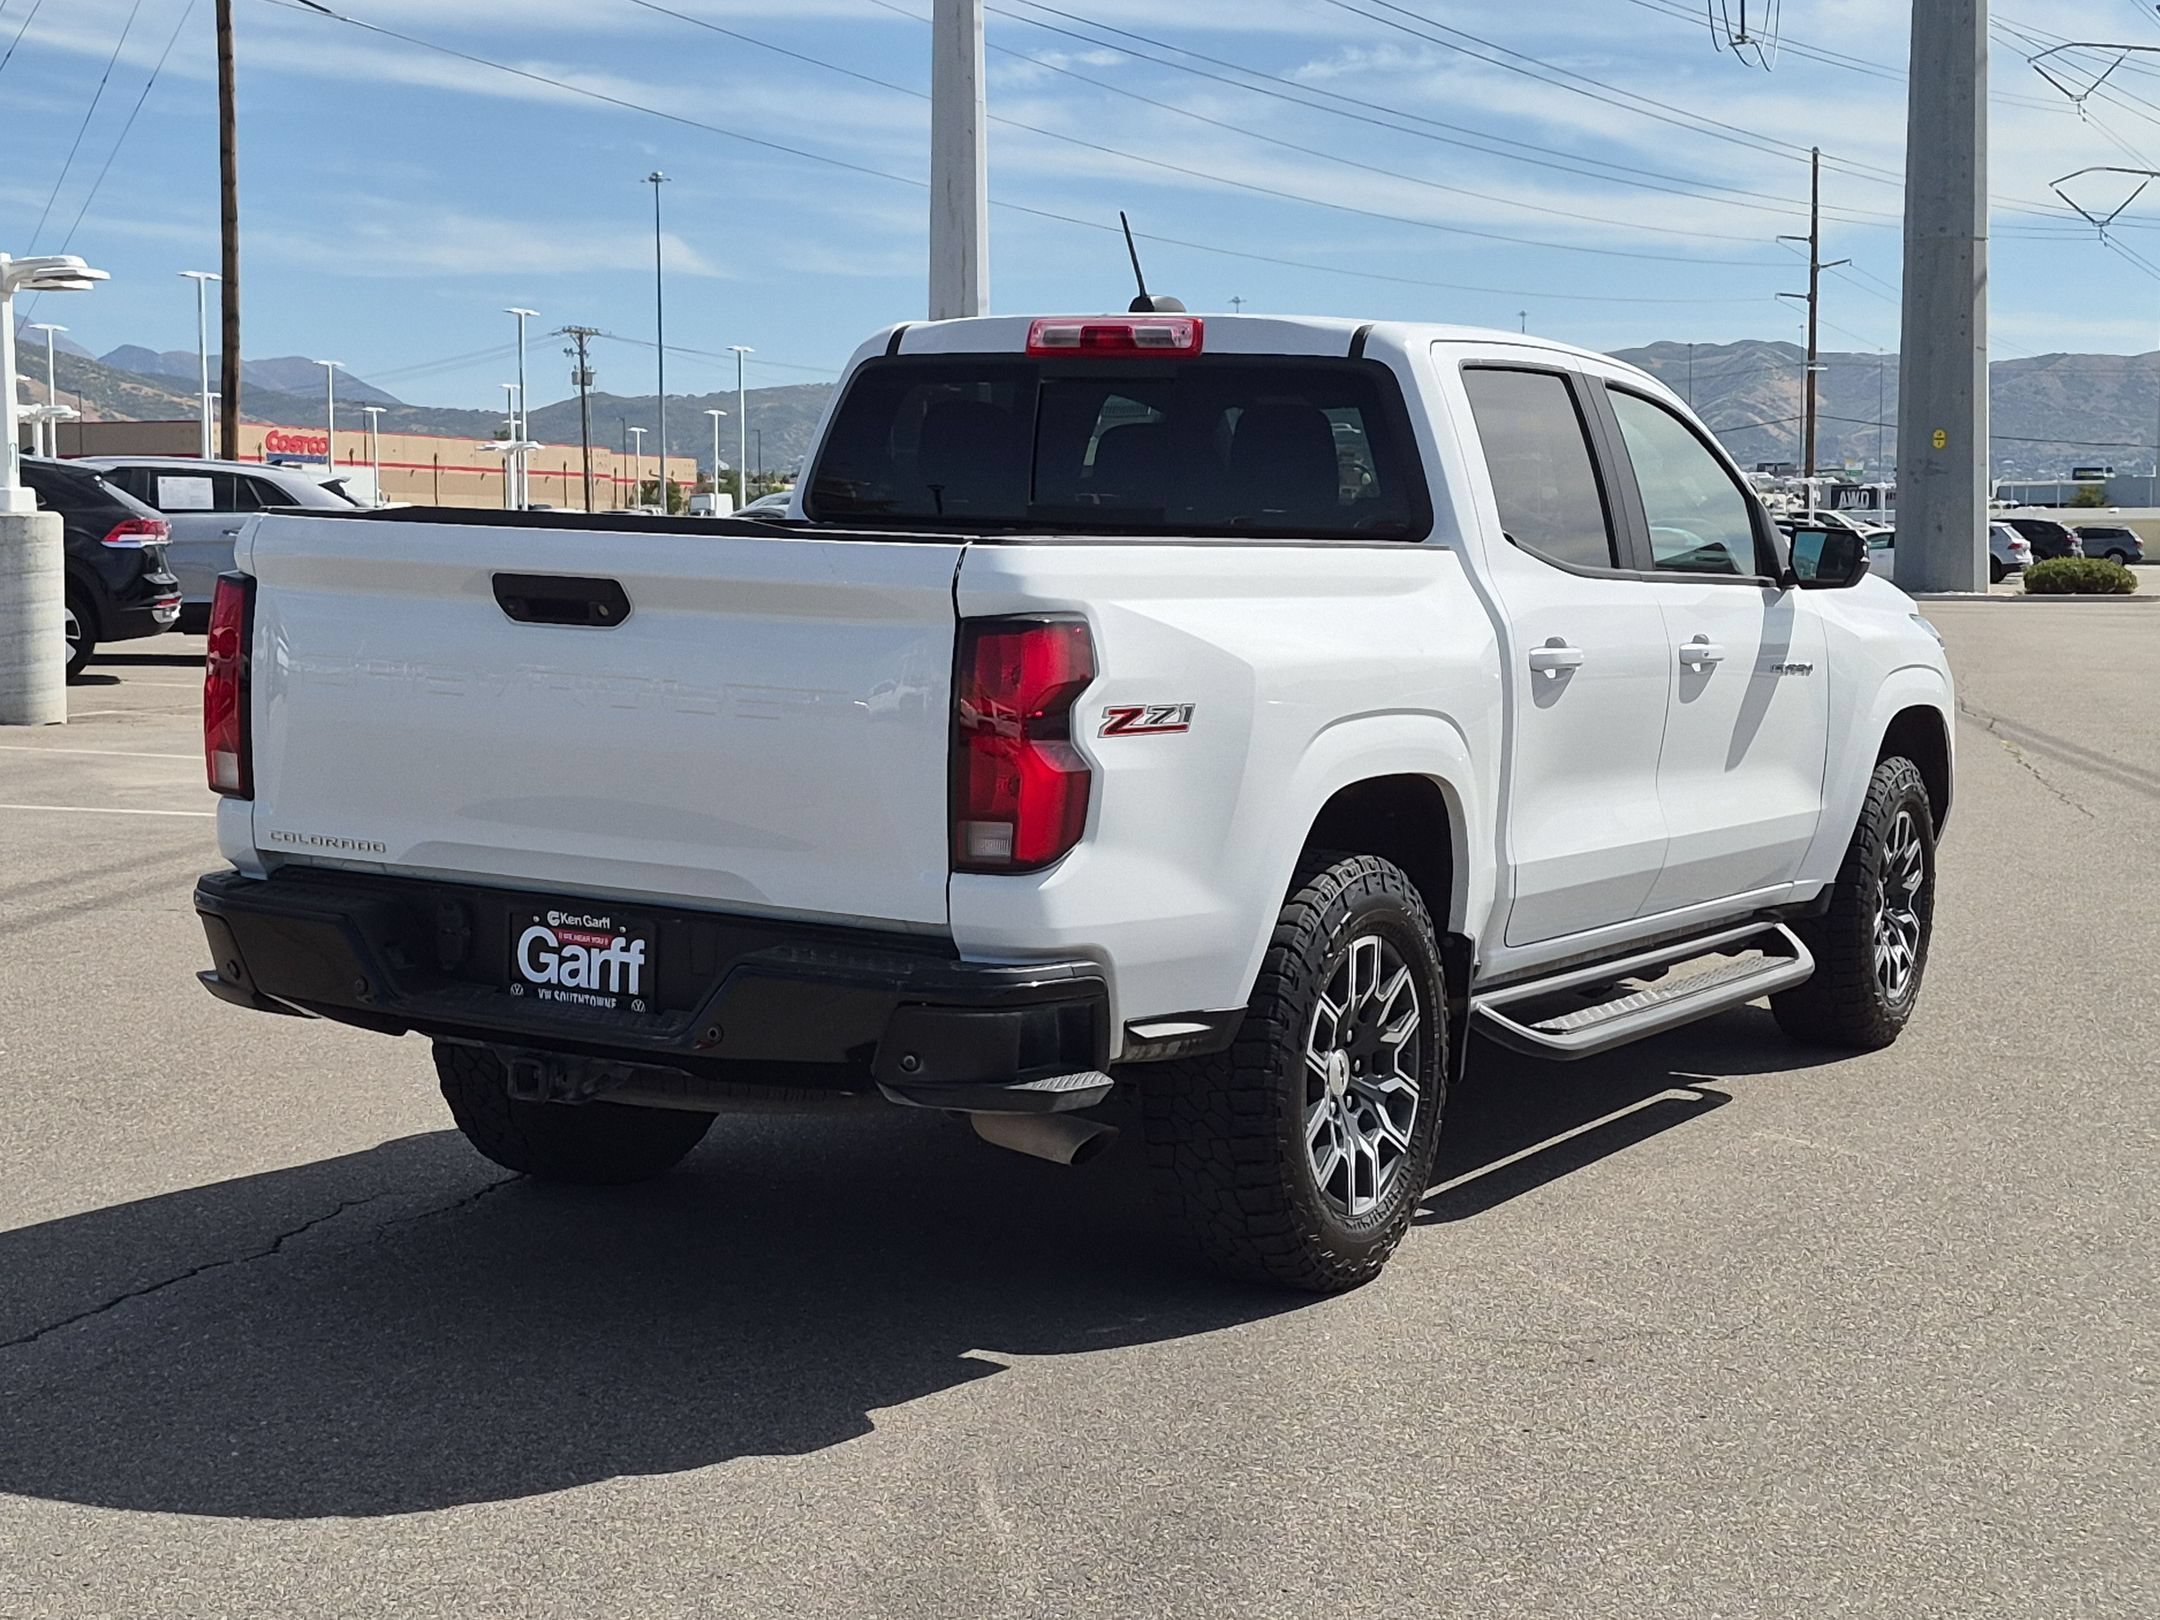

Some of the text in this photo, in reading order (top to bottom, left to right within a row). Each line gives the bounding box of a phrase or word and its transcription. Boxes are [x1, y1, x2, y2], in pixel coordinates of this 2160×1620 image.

[1097, 703, 1196, 739] Z71
[269, 831, 386, 853] COLORADO
[560, 912, 610, 929] Ken Garff
[517, 925, 646, 995] Garff
